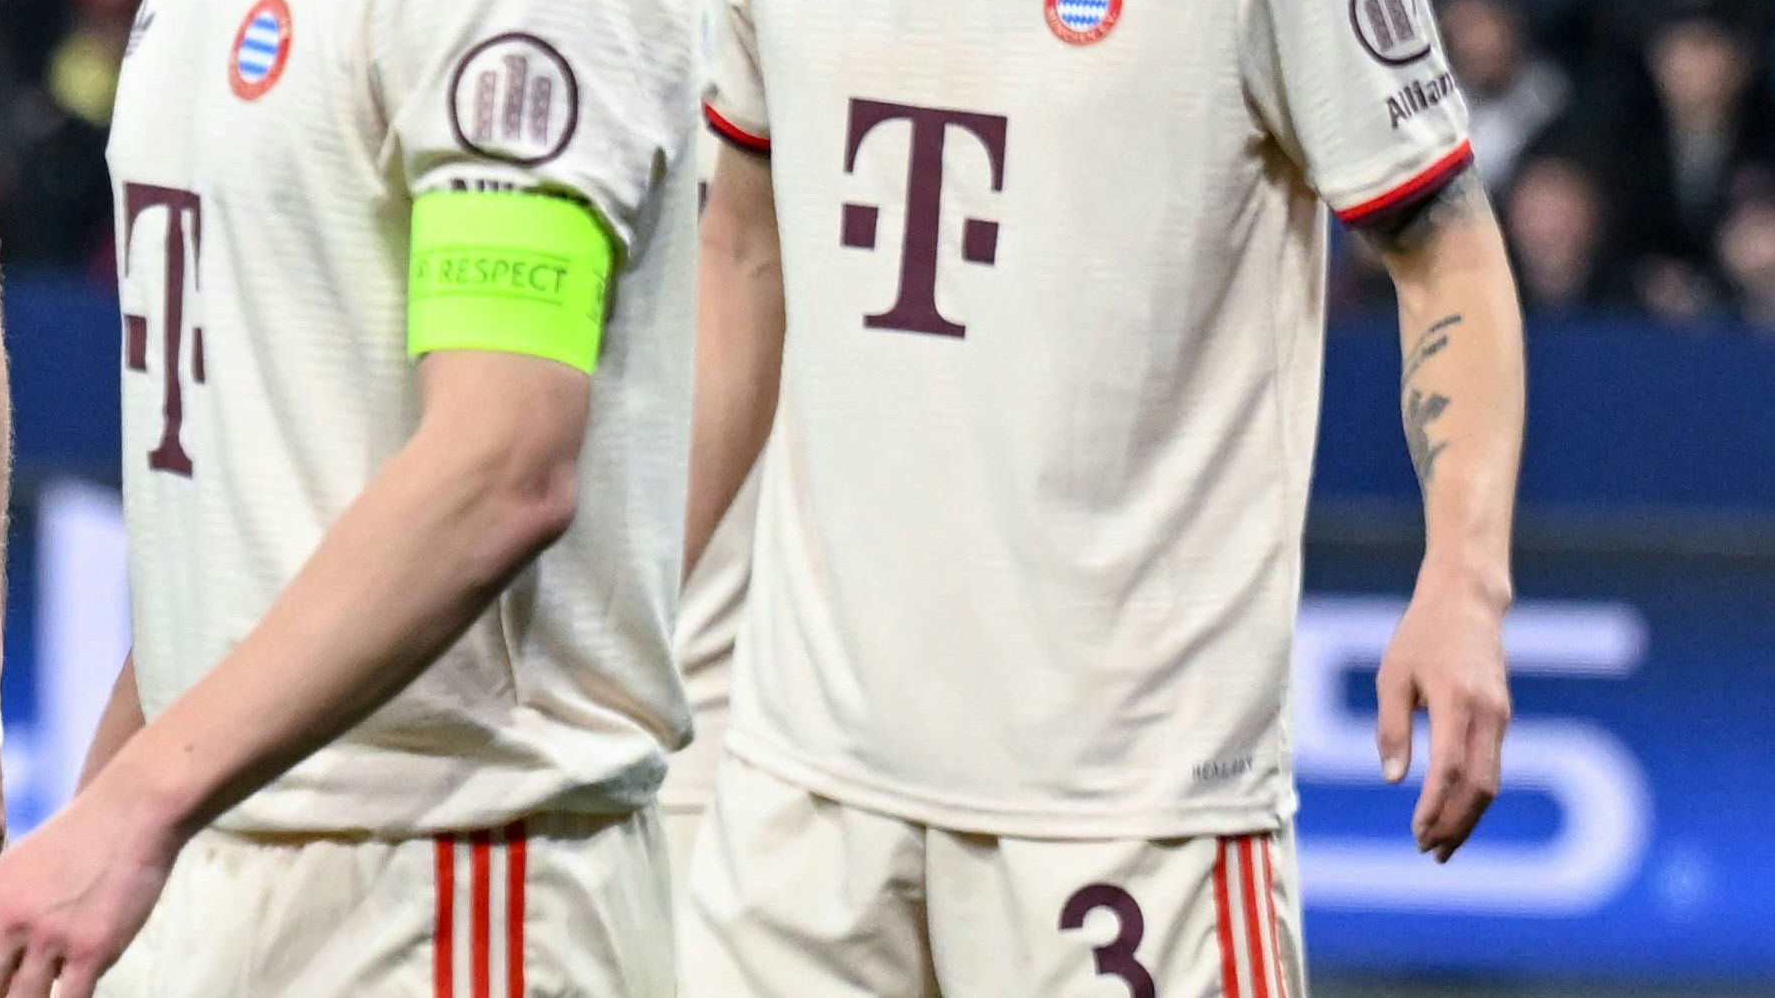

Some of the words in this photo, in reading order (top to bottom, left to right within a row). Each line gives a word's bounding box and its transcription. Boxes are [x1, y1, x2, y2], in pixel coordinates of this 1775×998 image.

[1386, 71, 1454, 130] Allian
[440, 258, 568, 294] RESPECT
[840, 98, 1007, 340] T
[122, 181, 205, 478] T
[1059, 883, 1156, 998] 3
